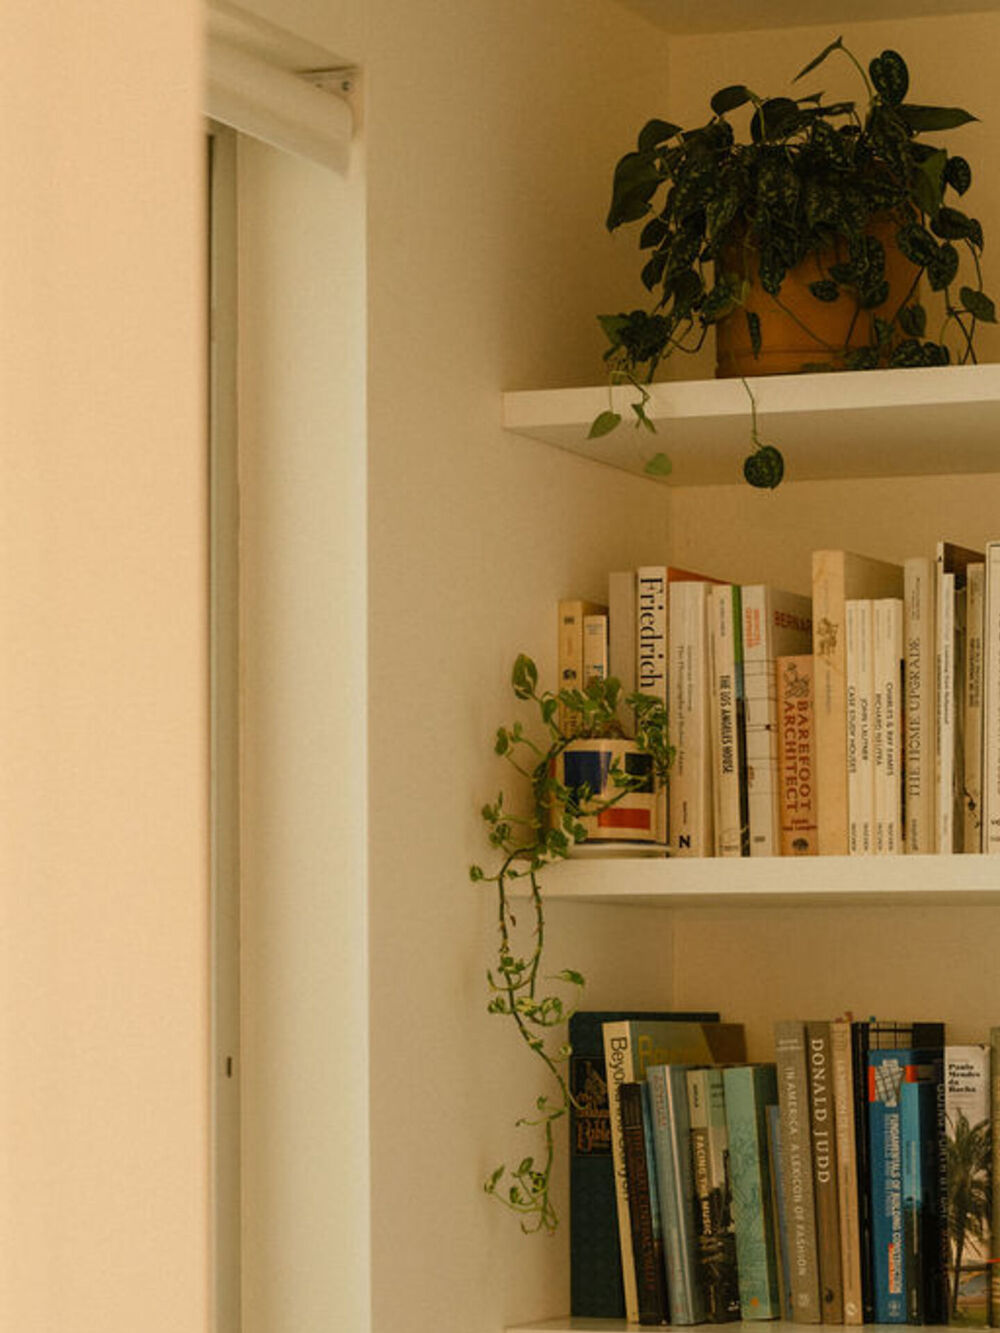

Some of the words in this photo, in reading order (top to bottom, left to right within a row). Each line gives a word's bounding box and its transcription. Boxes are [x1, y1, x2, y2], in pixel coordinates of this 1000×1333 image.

[640, 577, 664, 688] Friedrich
[719, 675, 731, 689] THE
[720, 692, 732, 706] LOS
[721, 709, 733, 744] ANGELES
[909, 718, 921, 761] HOME
[722, 746, 734, 774] HOUSE
[784, 701, 798, 812] ARCHITECT
[797, 701, 811, 811] BAREFOOT
[812, 1039, 827, 1122] DONALD
[815, 1129, 830, 1183] JUDD
[701, 1200, 712, 1236] MUSIC
